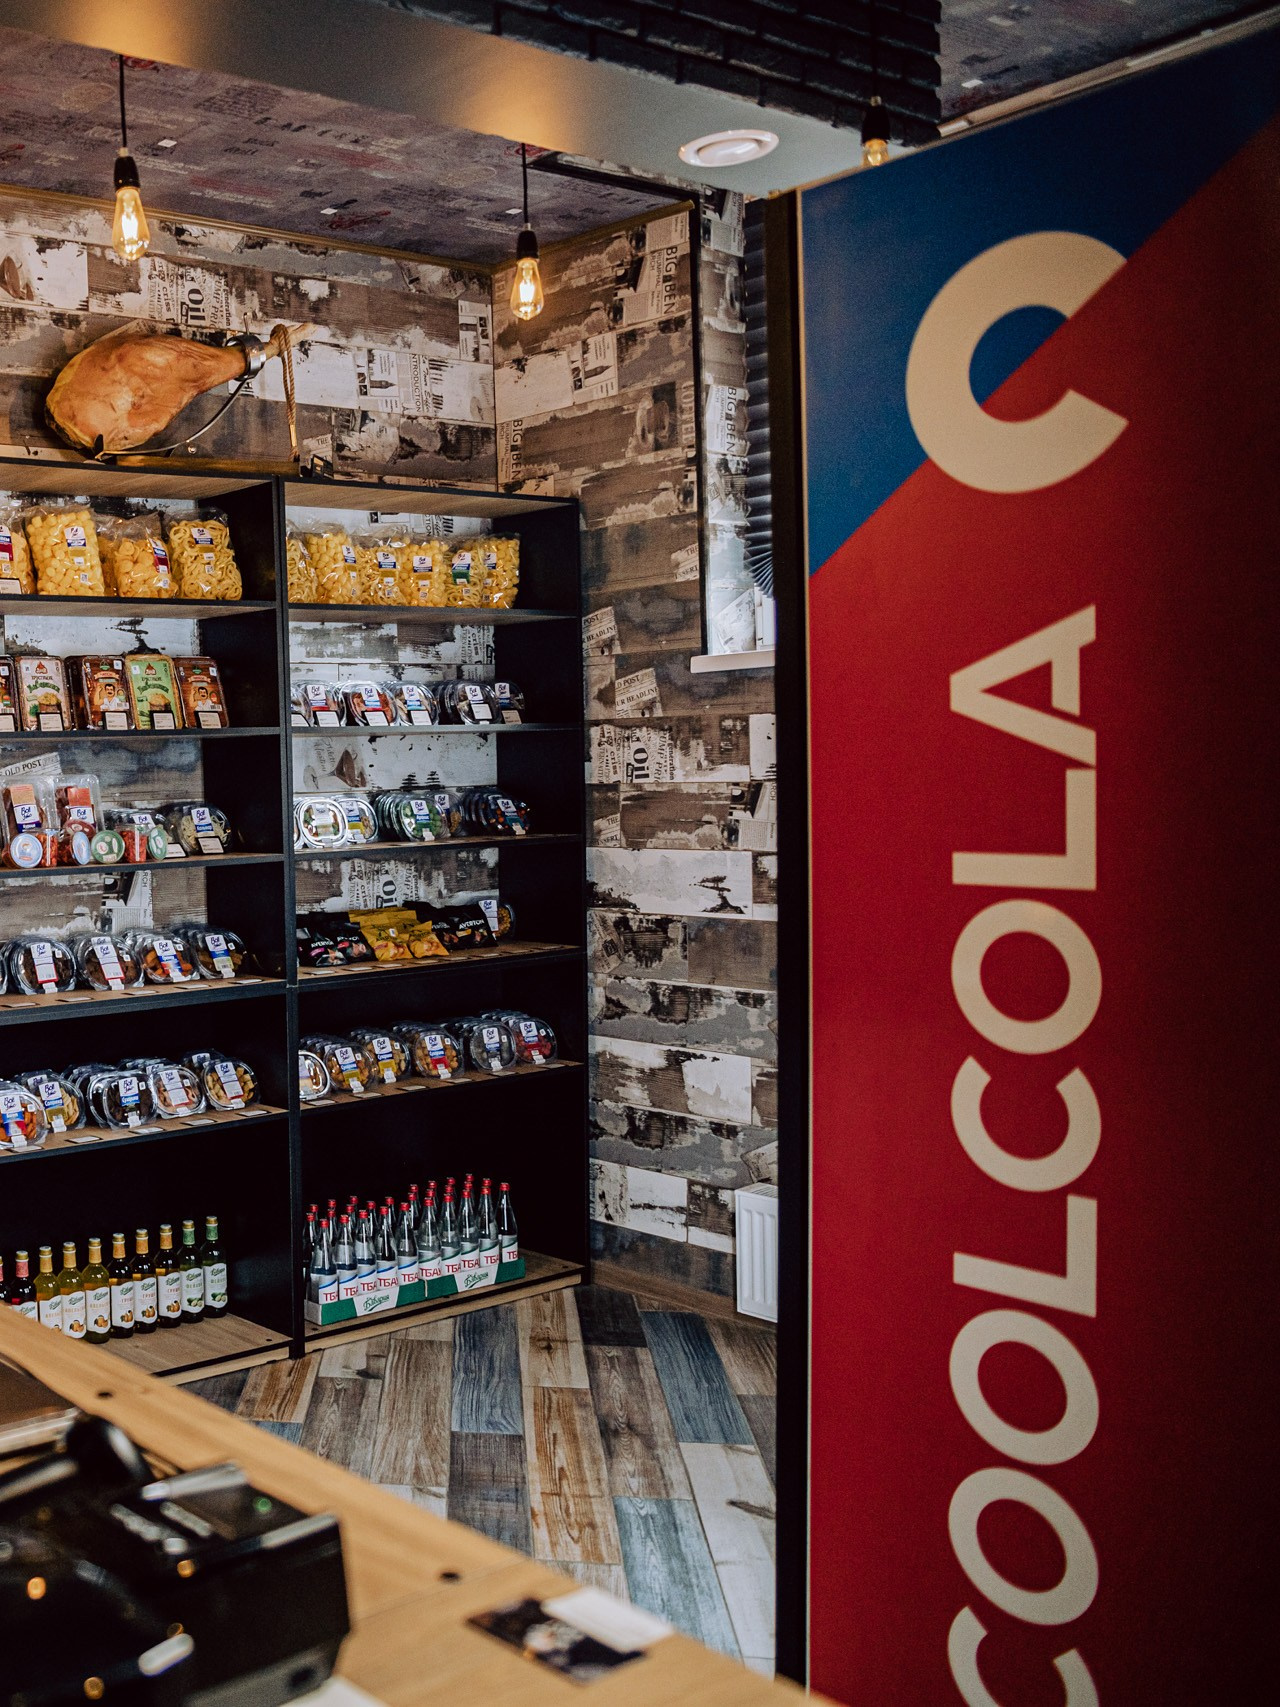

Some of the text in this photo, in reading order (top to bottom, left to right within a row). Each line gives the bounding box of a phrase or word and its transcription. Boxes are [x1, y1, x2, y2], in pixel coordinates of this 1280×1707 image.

[663, 246, 678, 315] BIG BEN
[188, 288, 206, 321] Oil
[906, 230, 1130, 494] C
[726, 386, 737, 453] BIG BEN
[510, 420, 523, 480] BIG BEN
[583, 614, 600, 625] POST
[623, 675, 641, 687] POST
[22, 758, 42, 772] POST
[632, 747, 650, 780] Oil
